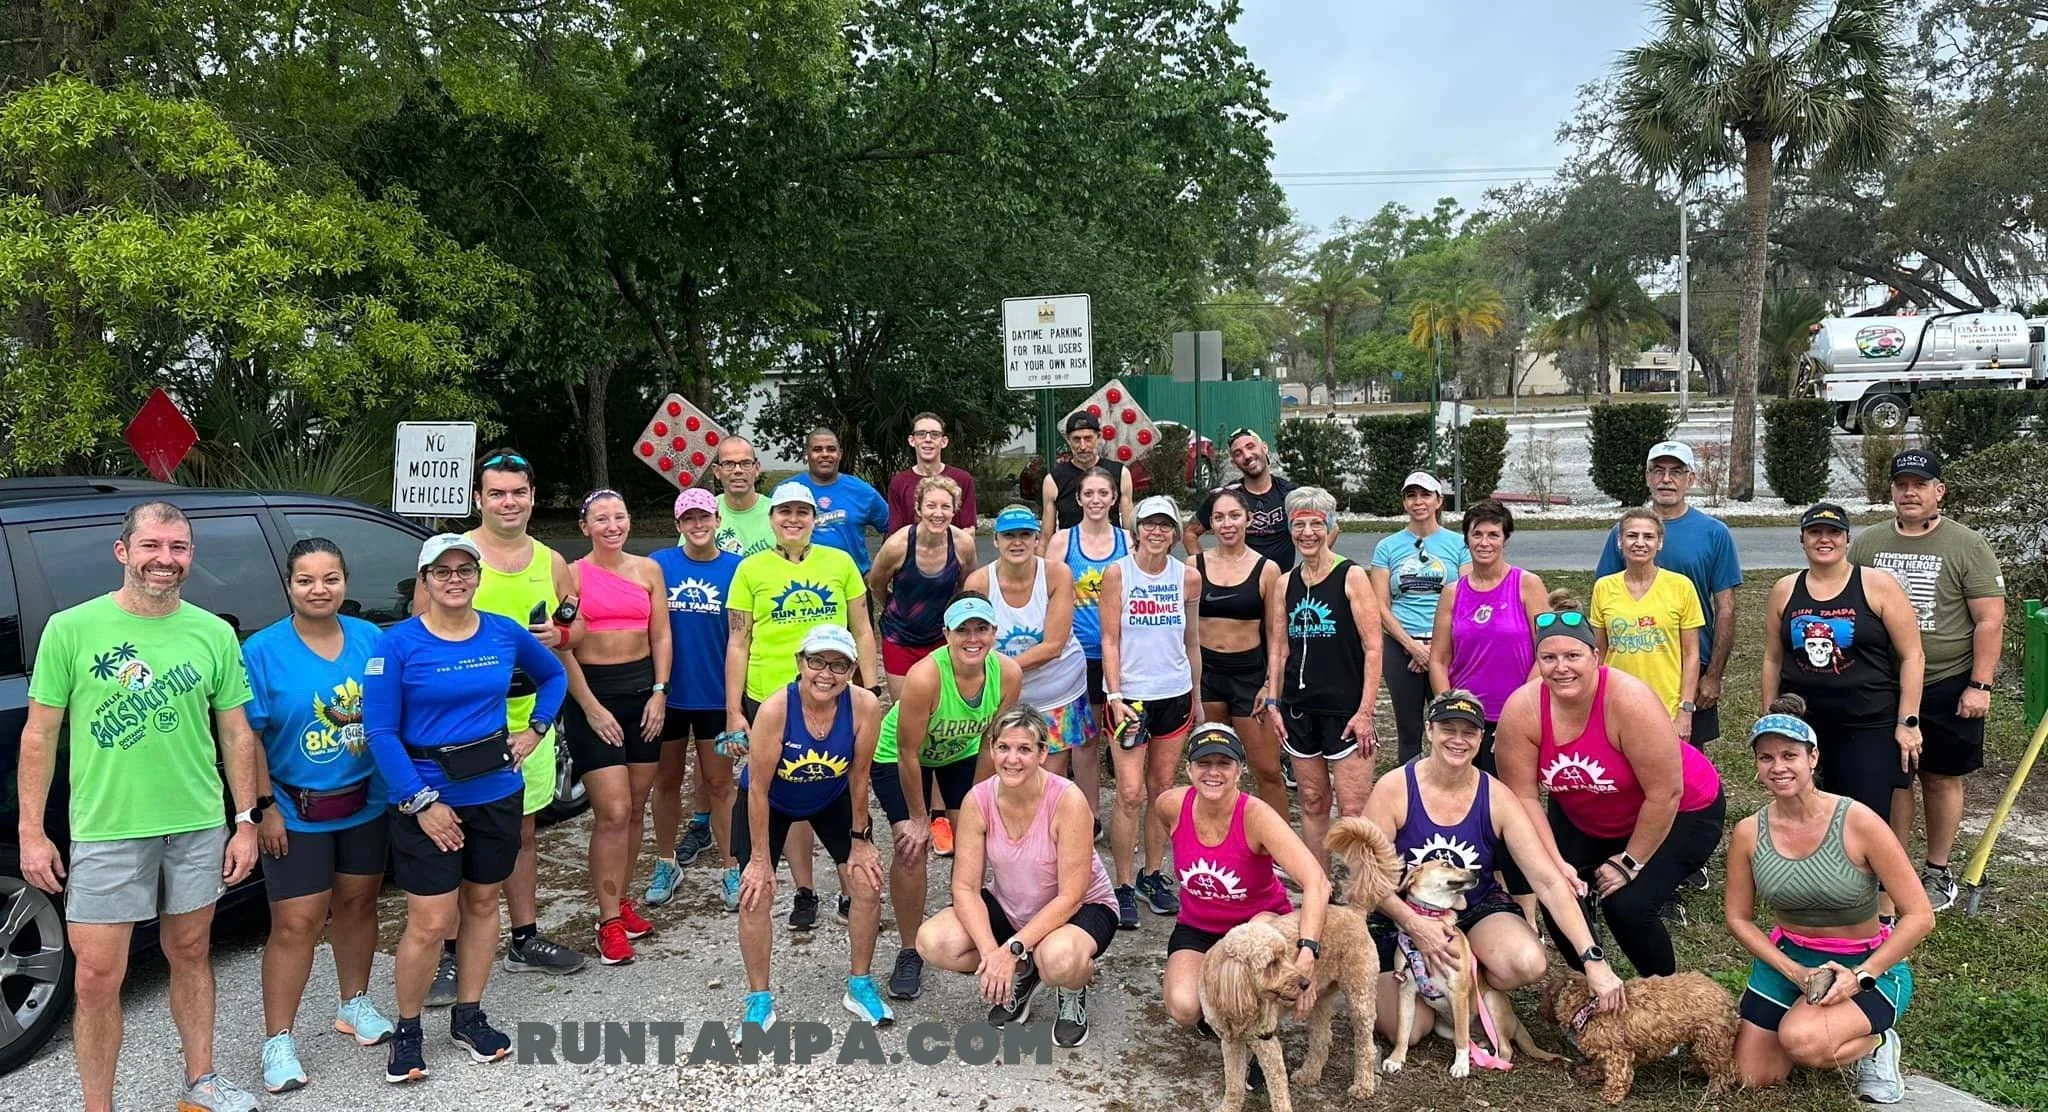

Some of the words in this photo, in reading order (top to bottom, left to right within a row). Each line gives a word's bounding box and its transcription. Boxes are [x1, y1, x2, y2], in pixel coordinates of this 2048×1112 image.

[1012, 328, 1043, 341] DAYTIME
[1050, 327, 1082, 339] PARKING
[1013, 345, 1027, 356] FOR
[1033, 344, 1053, 355] TRAIL
[1059, 342, 1082, 354] USERS
[1010, 361, 1018, 371] AT
[1024, 360, 1044, 370] YOUR
[1049, 359, 1066, 369] OWN
[1070, 358, 1087, 369] RISK
[426, 434, 445, 452] NO
[1896, 454, 1927, 467] PASCO
[409, 460, 459, 478] MOTOR
[402, 486, 464, 504] VEHICLES
[1880, 552, 1918, 560] REMEMBER
[1873, 558, 1904, 569] FALLEN
[1906, 560, 1942, 571] HEROES
[1153, 593, 1178, 601] TRIPLE
[689, 602, 720, 612] TAMPA
[771, 609, 796, 619] RUN
[800, 606, 837, 616] TAMPA
[1792, 608, 1813, 618] RUN
[1820, 608, 1857, 617] TAMPA
[1129, 615, 1182, 626] CHALLENGE
[95, 691, 123, 715] PUBLIX
[158, 712, 178, 722] 15K
[118, 725, 147, 746] DISTANCE
[122, 731, 147, 751] CLASSIC
[305, 729, 338, 751] 8K
